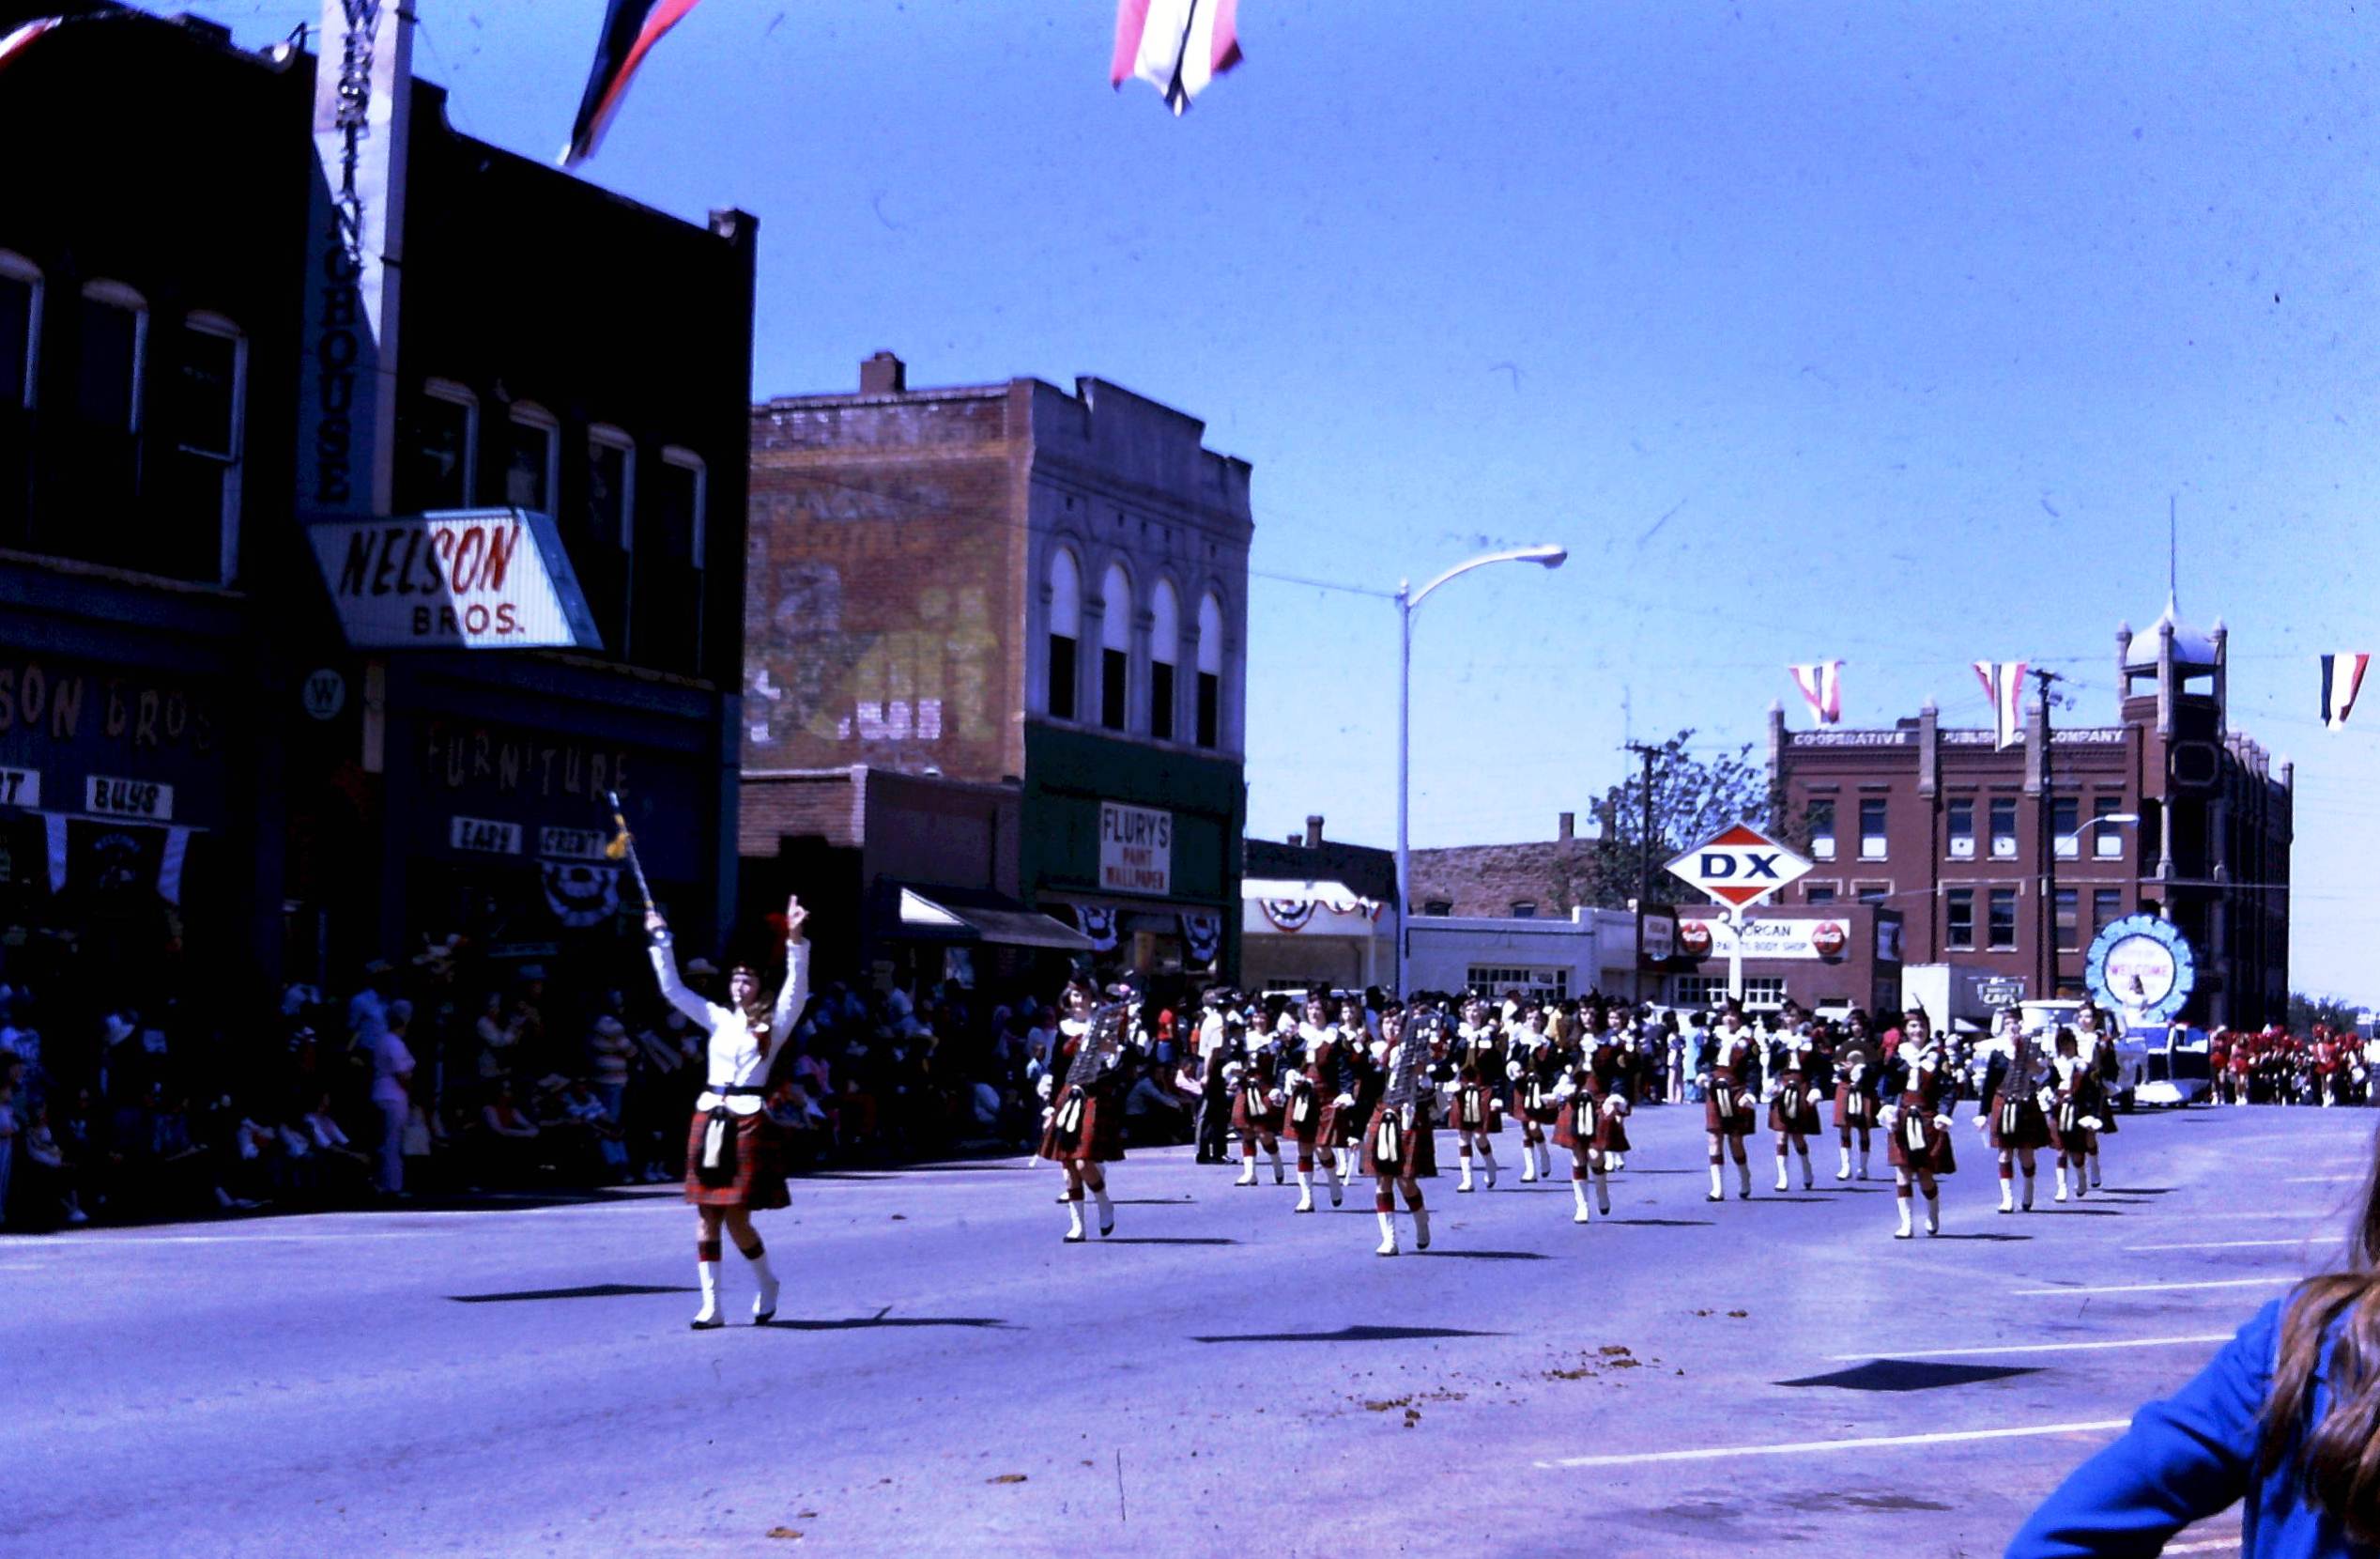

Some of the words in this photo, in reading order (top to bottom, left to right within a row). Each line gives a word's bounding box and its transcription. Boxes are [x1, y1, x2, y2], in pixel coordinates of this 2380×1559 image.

[340, 526, 520, 595] NELSON
[413, 603, 526, 635] BROS.
[95, 778, 160, 813] BUYS
[1123, 846, 1154, 866] PAINT
[1700, 854, 1781, 878] DX
[1106, 866, 1165, 889] WALLPAPER
